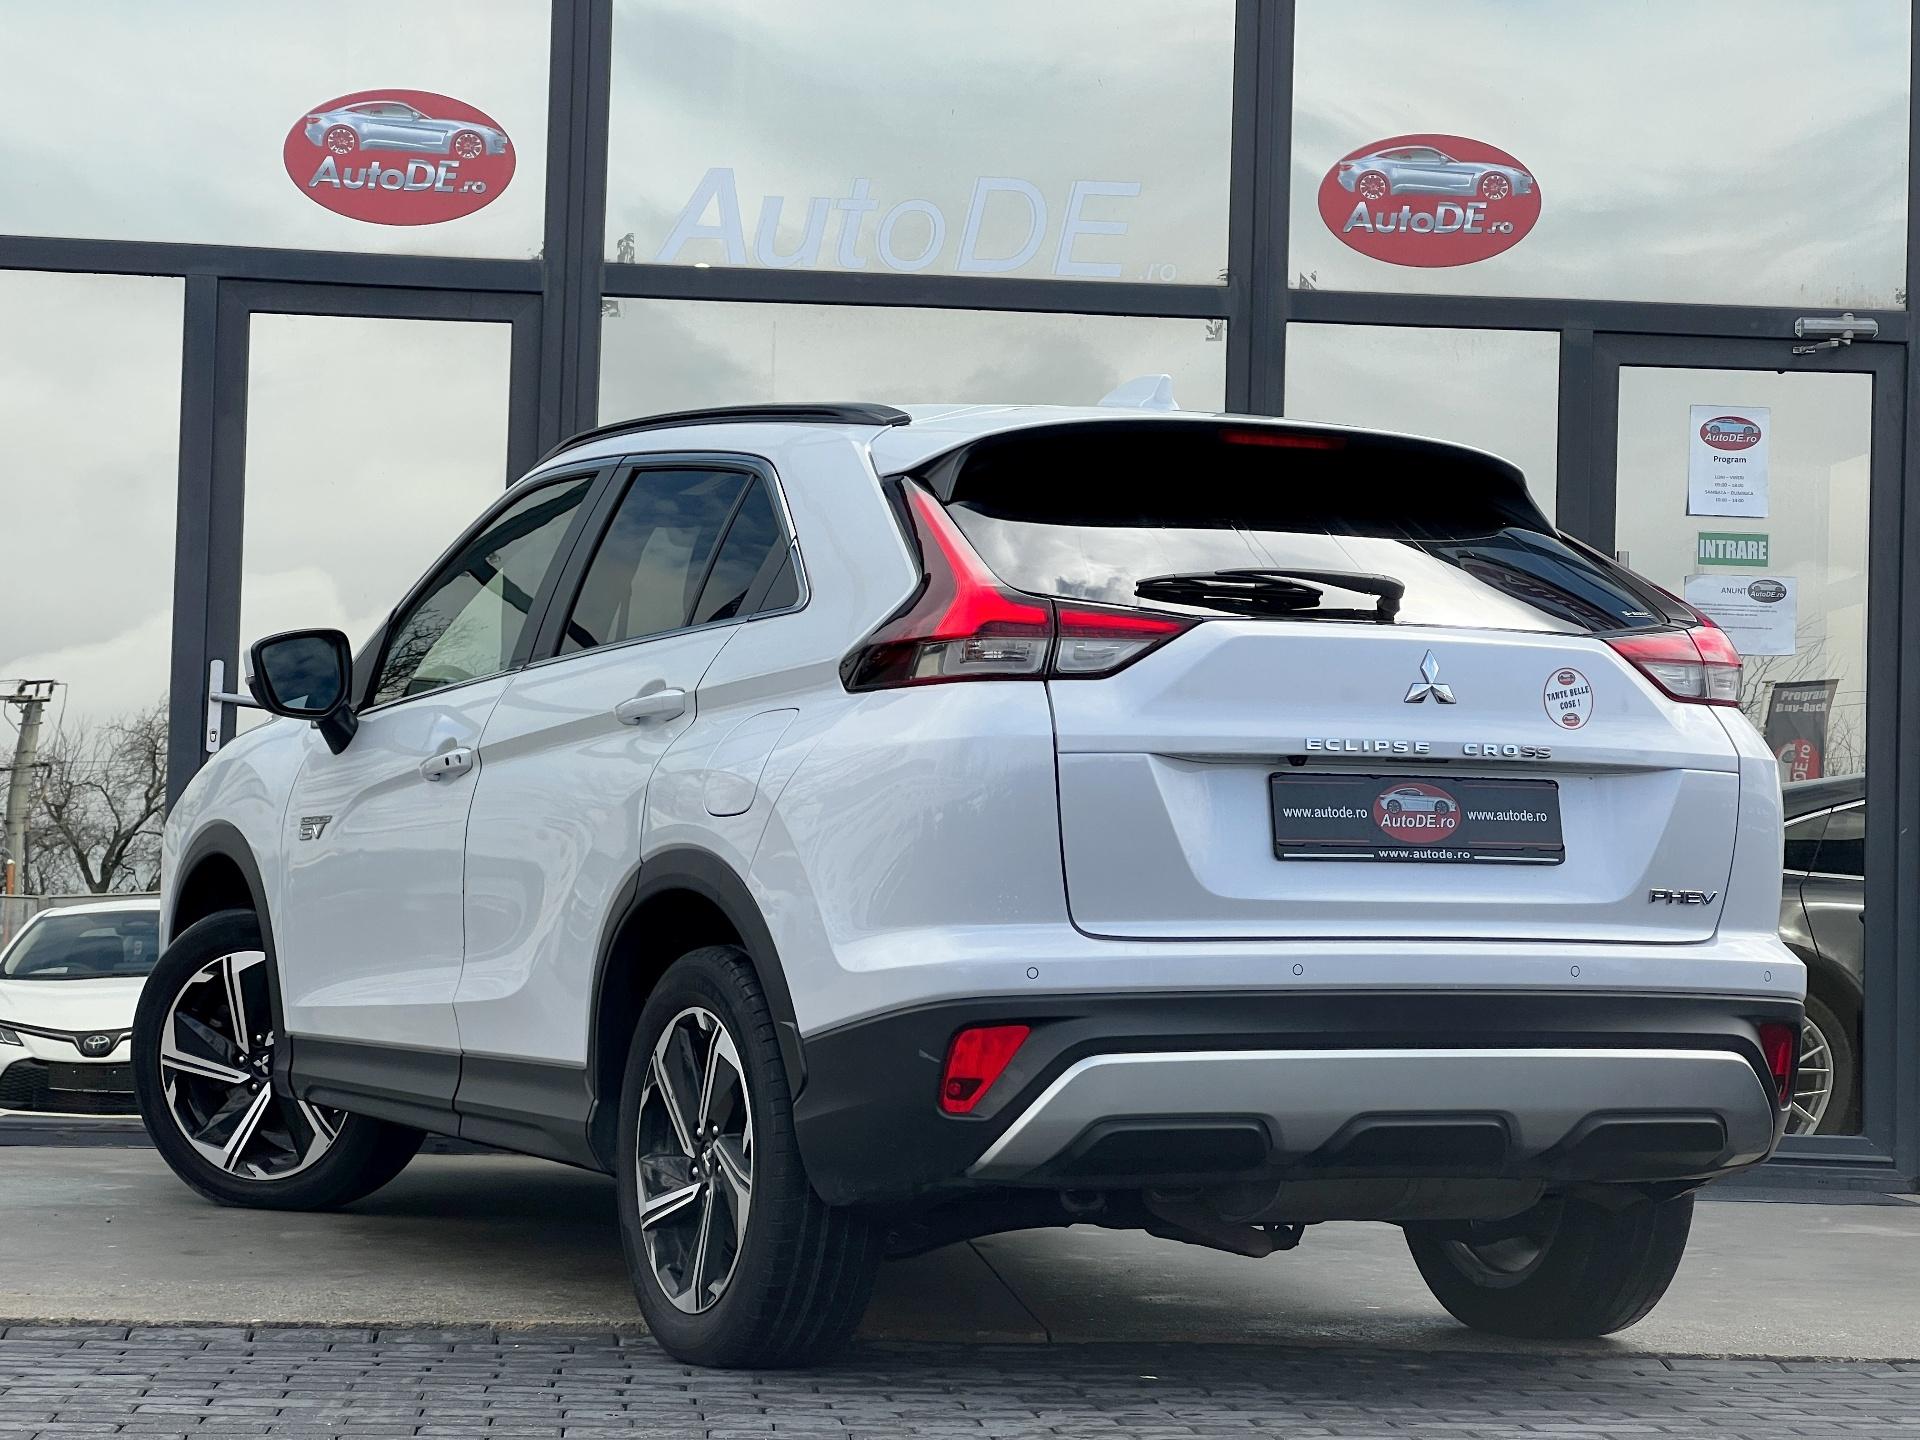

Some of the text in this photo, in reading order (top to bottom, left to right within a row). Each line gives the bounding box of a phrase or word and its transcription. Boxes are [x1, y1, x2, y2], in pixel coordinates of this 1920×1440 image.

[1705, 432, 1757, 443] AutoDE.ro
[1713, 455, 1747, 464] Program
[1700, 539, 1767, 560] INTRARE
[1569, 686, 1589, 696] BELLE
[1781, 689, 1829, 702] Program
[1560, 700, 1576, 710] COSE
[1305, 738, 1552, 759] ECLIPSE CROSS
[1283, 806, 1368, 818] www.autode.ro
[1467, 810, 1548, 822] www.autode.ro
[1380, 813, 1456, 829] AutoDE.ro
[1379, 849, 1471, 859] www.autode.ro
[1648, 888, 1718, 905] PHEV
